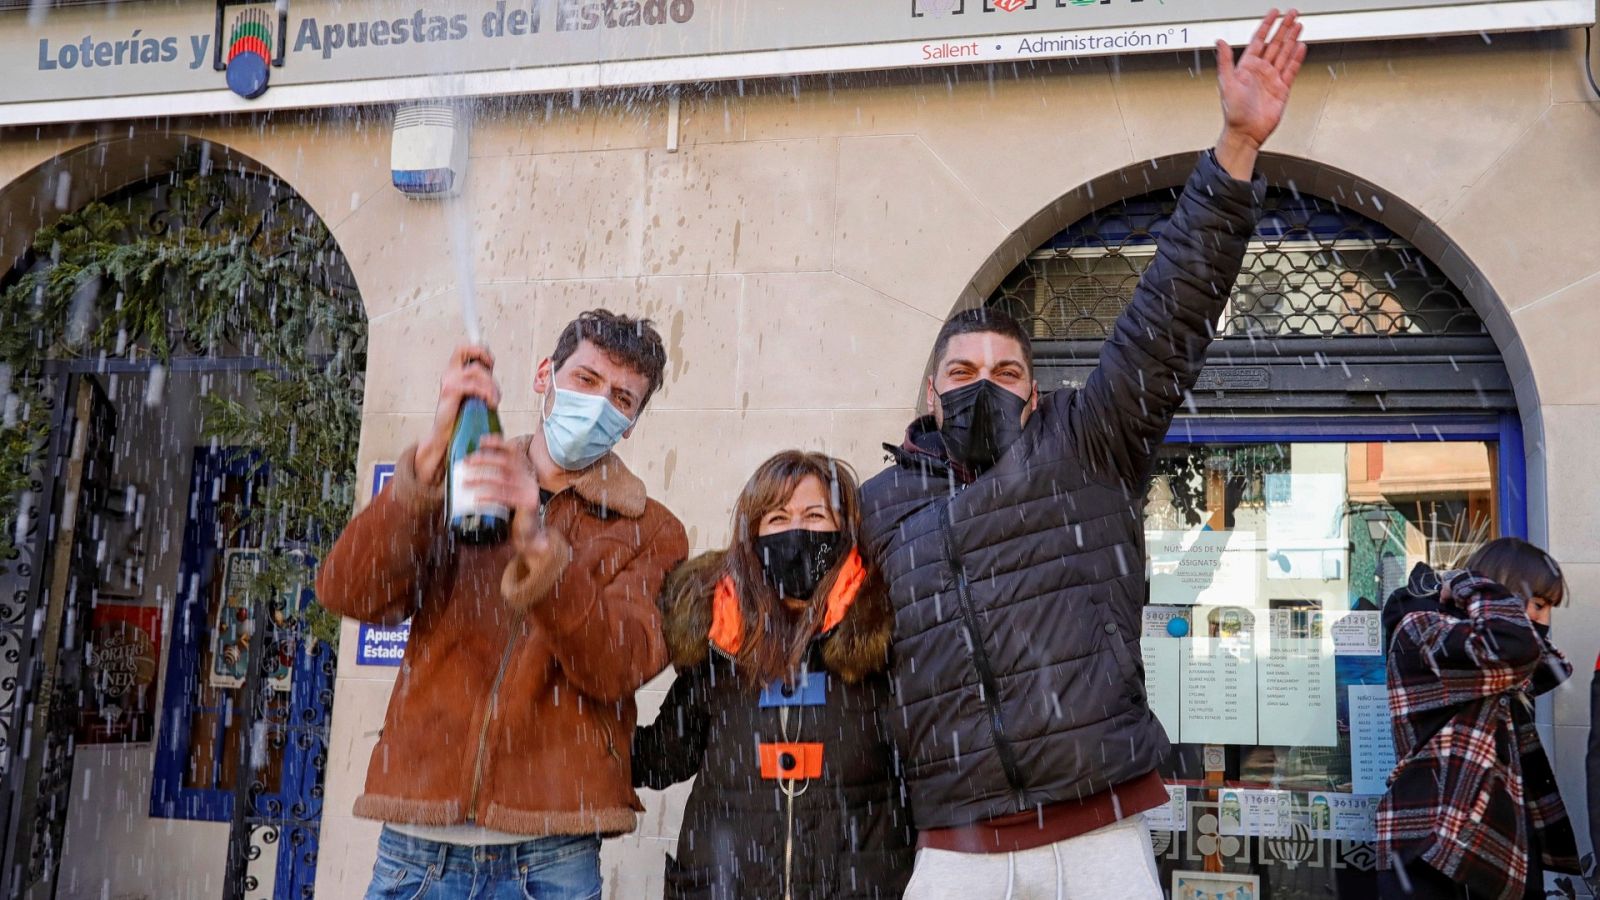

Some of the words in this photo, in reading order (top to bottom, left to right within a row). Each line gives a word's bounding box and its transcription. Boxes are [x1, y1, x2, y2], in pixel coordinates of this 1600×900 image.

[38, 29, 178, 71] Loterías
[189, 34, 210, 69] y
[293, 9, 469, 60] Apuestas
[481, 4, 541, 37] del
[556, 0, 695, 33] Estado
[922, 42, 979, 60] Sallent
[1017, 31, 1152, 54] Administración
[1180, 28, 1188, 44] 1
